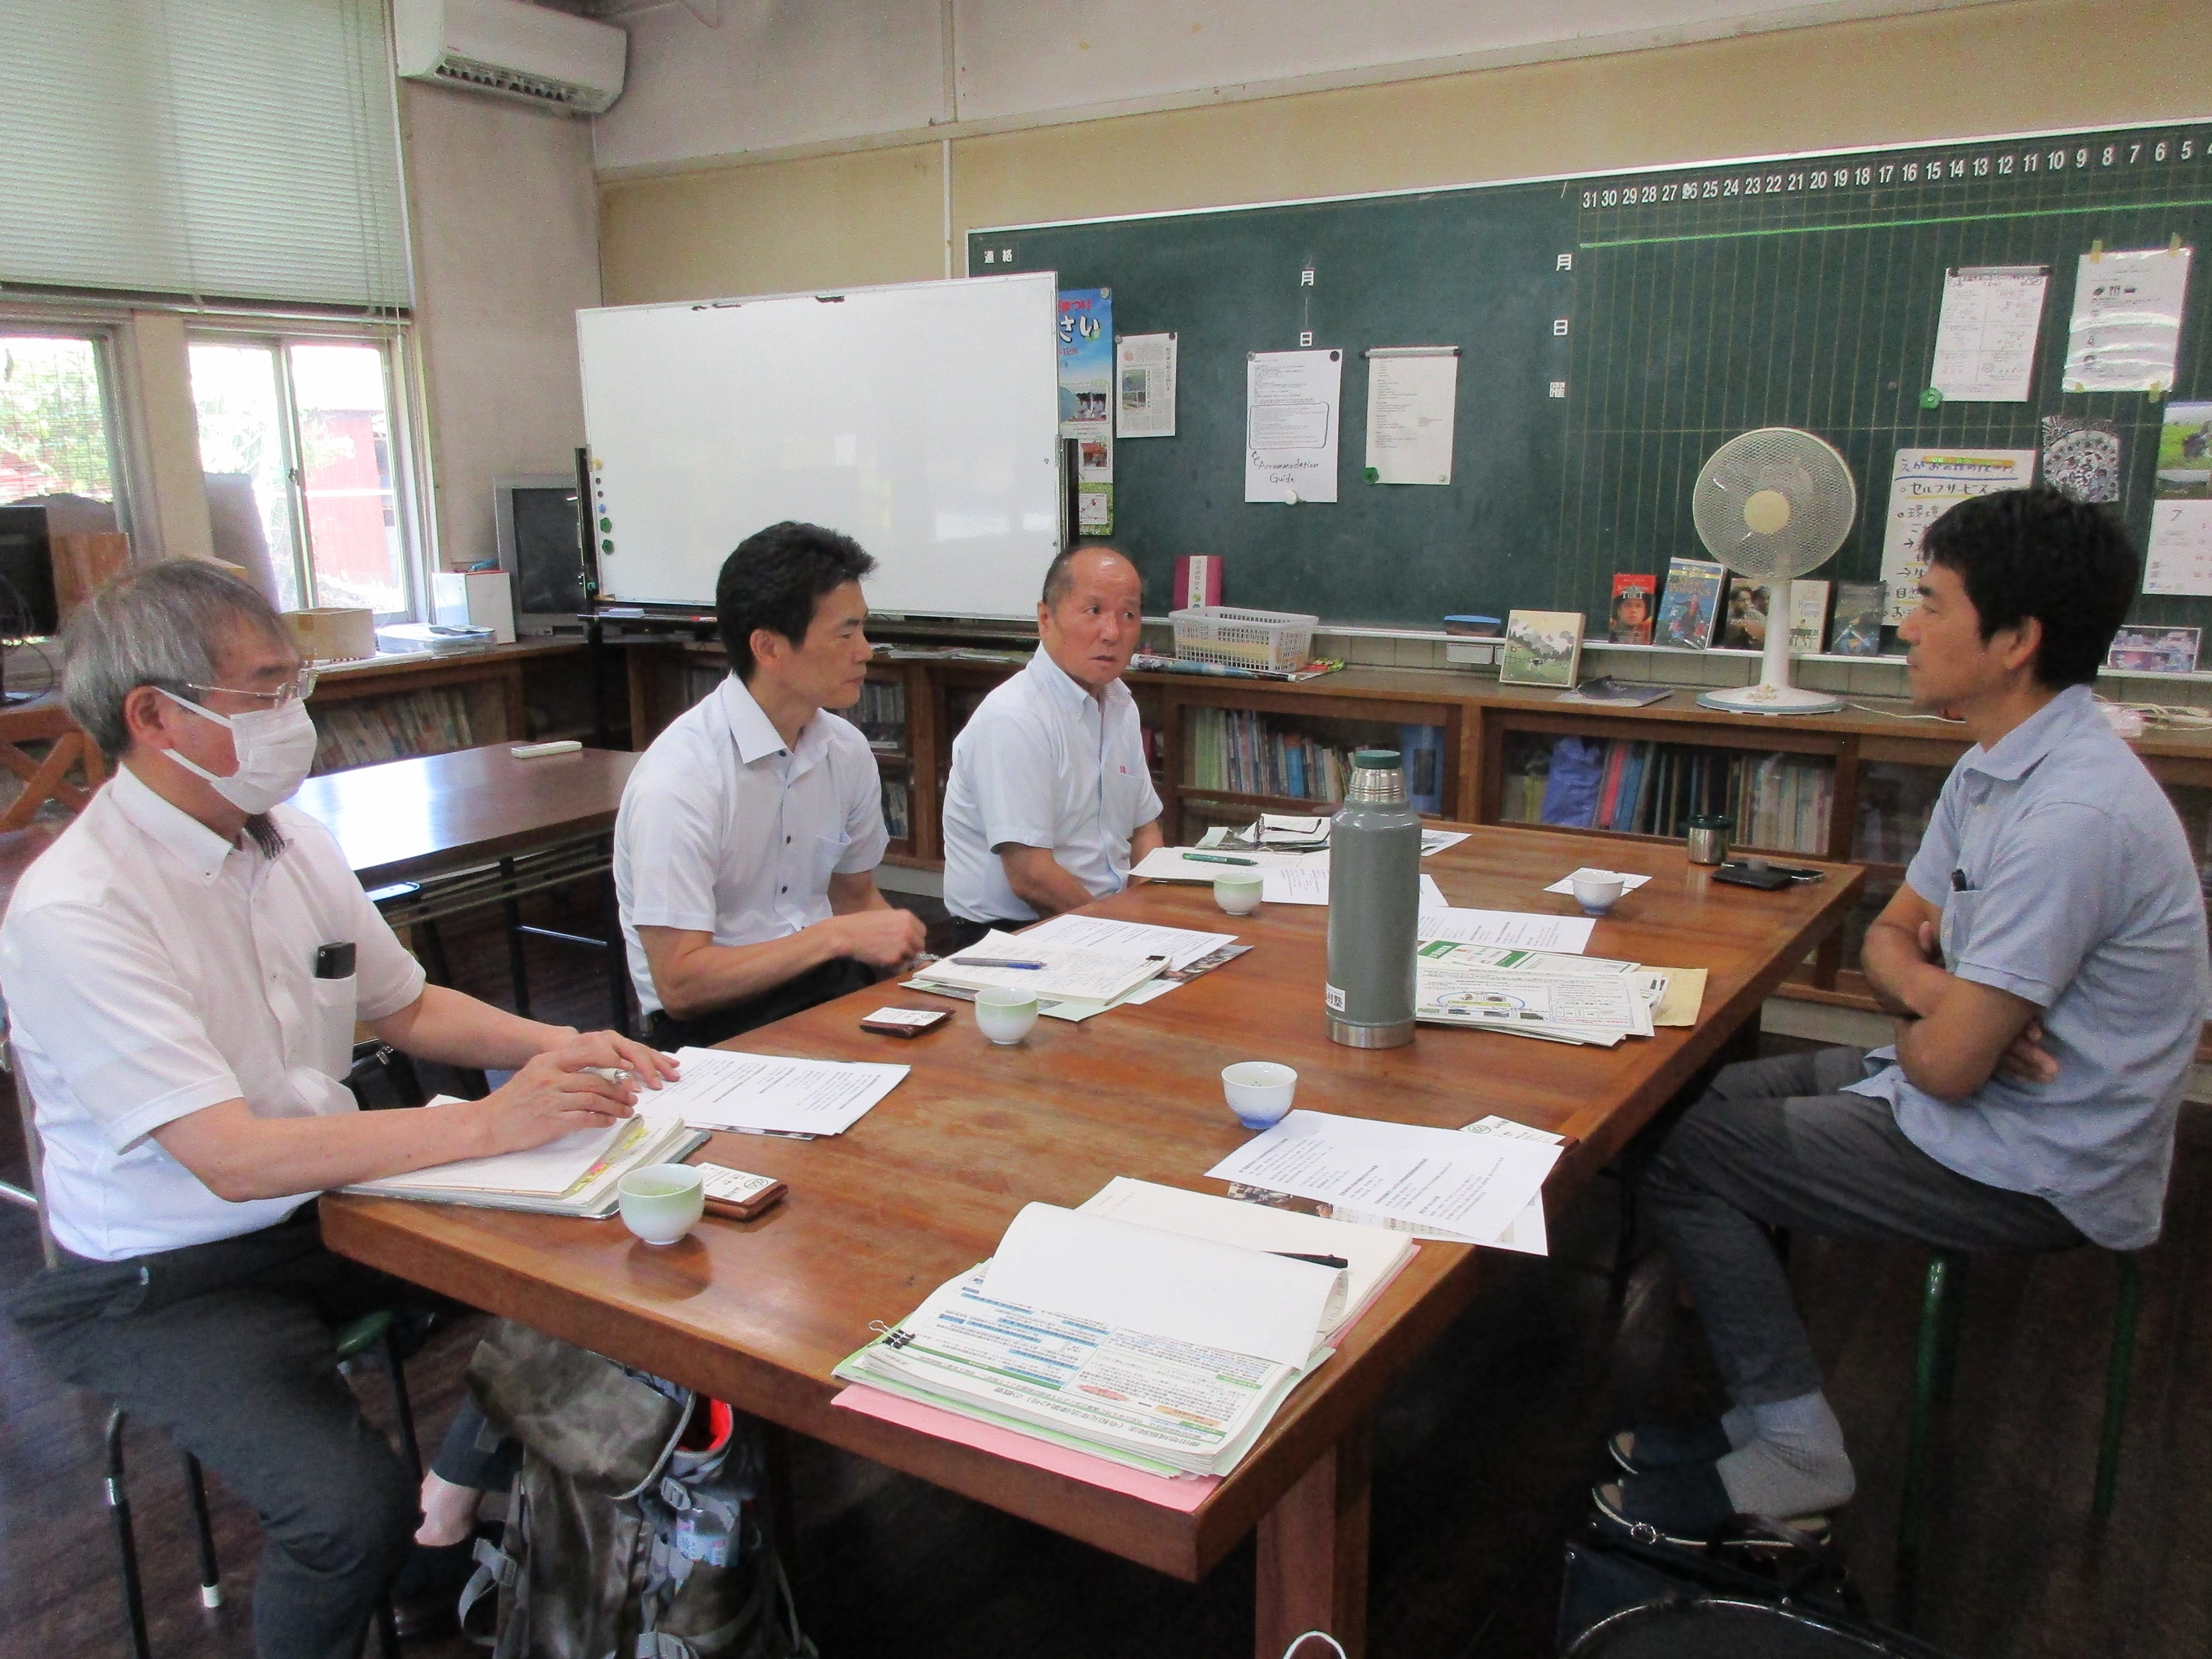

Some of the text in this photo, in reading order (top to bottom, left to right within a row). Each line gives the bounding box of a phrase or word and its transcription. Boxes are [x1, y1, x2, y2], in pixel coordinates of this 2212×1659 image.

[1583, 192, 1597, 208] 31
[1601, 190, 1617, 207] 30
[1622, 187, 1637, 205] 29
[1641, 186, 1657, 203] 28
[1662, 184, 1678, 201] 27
[1702, 180, 1718, 198] 25
[1723, 179, 1739, 196] 24
[1744, 177, 1760, 194] 23
[1765, 175, 1782, 193] 22
[1788, 173, 1803, 190] 21
[1810, 171, 1827, 189] 20
[1833, 169, 1849, 187] 19
[1854, 167, 1871, 185] 18
[1879, 166, 1894, 183] 17
[1902, 163, 1917, 181] 16
[1926, 161, 1941, 180] 15
[1949, 159, 1964, 178] 14
[1973, 158, 1988, 176] 13
[1998, 156, 2013, 174] 12
[2024, 153, 2039, 172] 11
[2047, 150, 2065, 170] 10
[2076, 148, 2088, 168] 9
[2102, 146, 2114, 166] 8
[2130, 145, 2141, 163] 7
[2155, 142, 2167, 161] 6
[2181, 140, 2193, 160] 5
[1299, 270, 1314, 347] 月 日
[1059, 315, 1100, 343] さい
[1549, 254, 1572, 399] 月 日 曜
[1258, 458, 1318, 470] Accommodation
[1270, 473, 1295, 484] Guide
[1912, 483, 1988, 495] セルフサービス
[2172, 510, 2183, 521] 7
